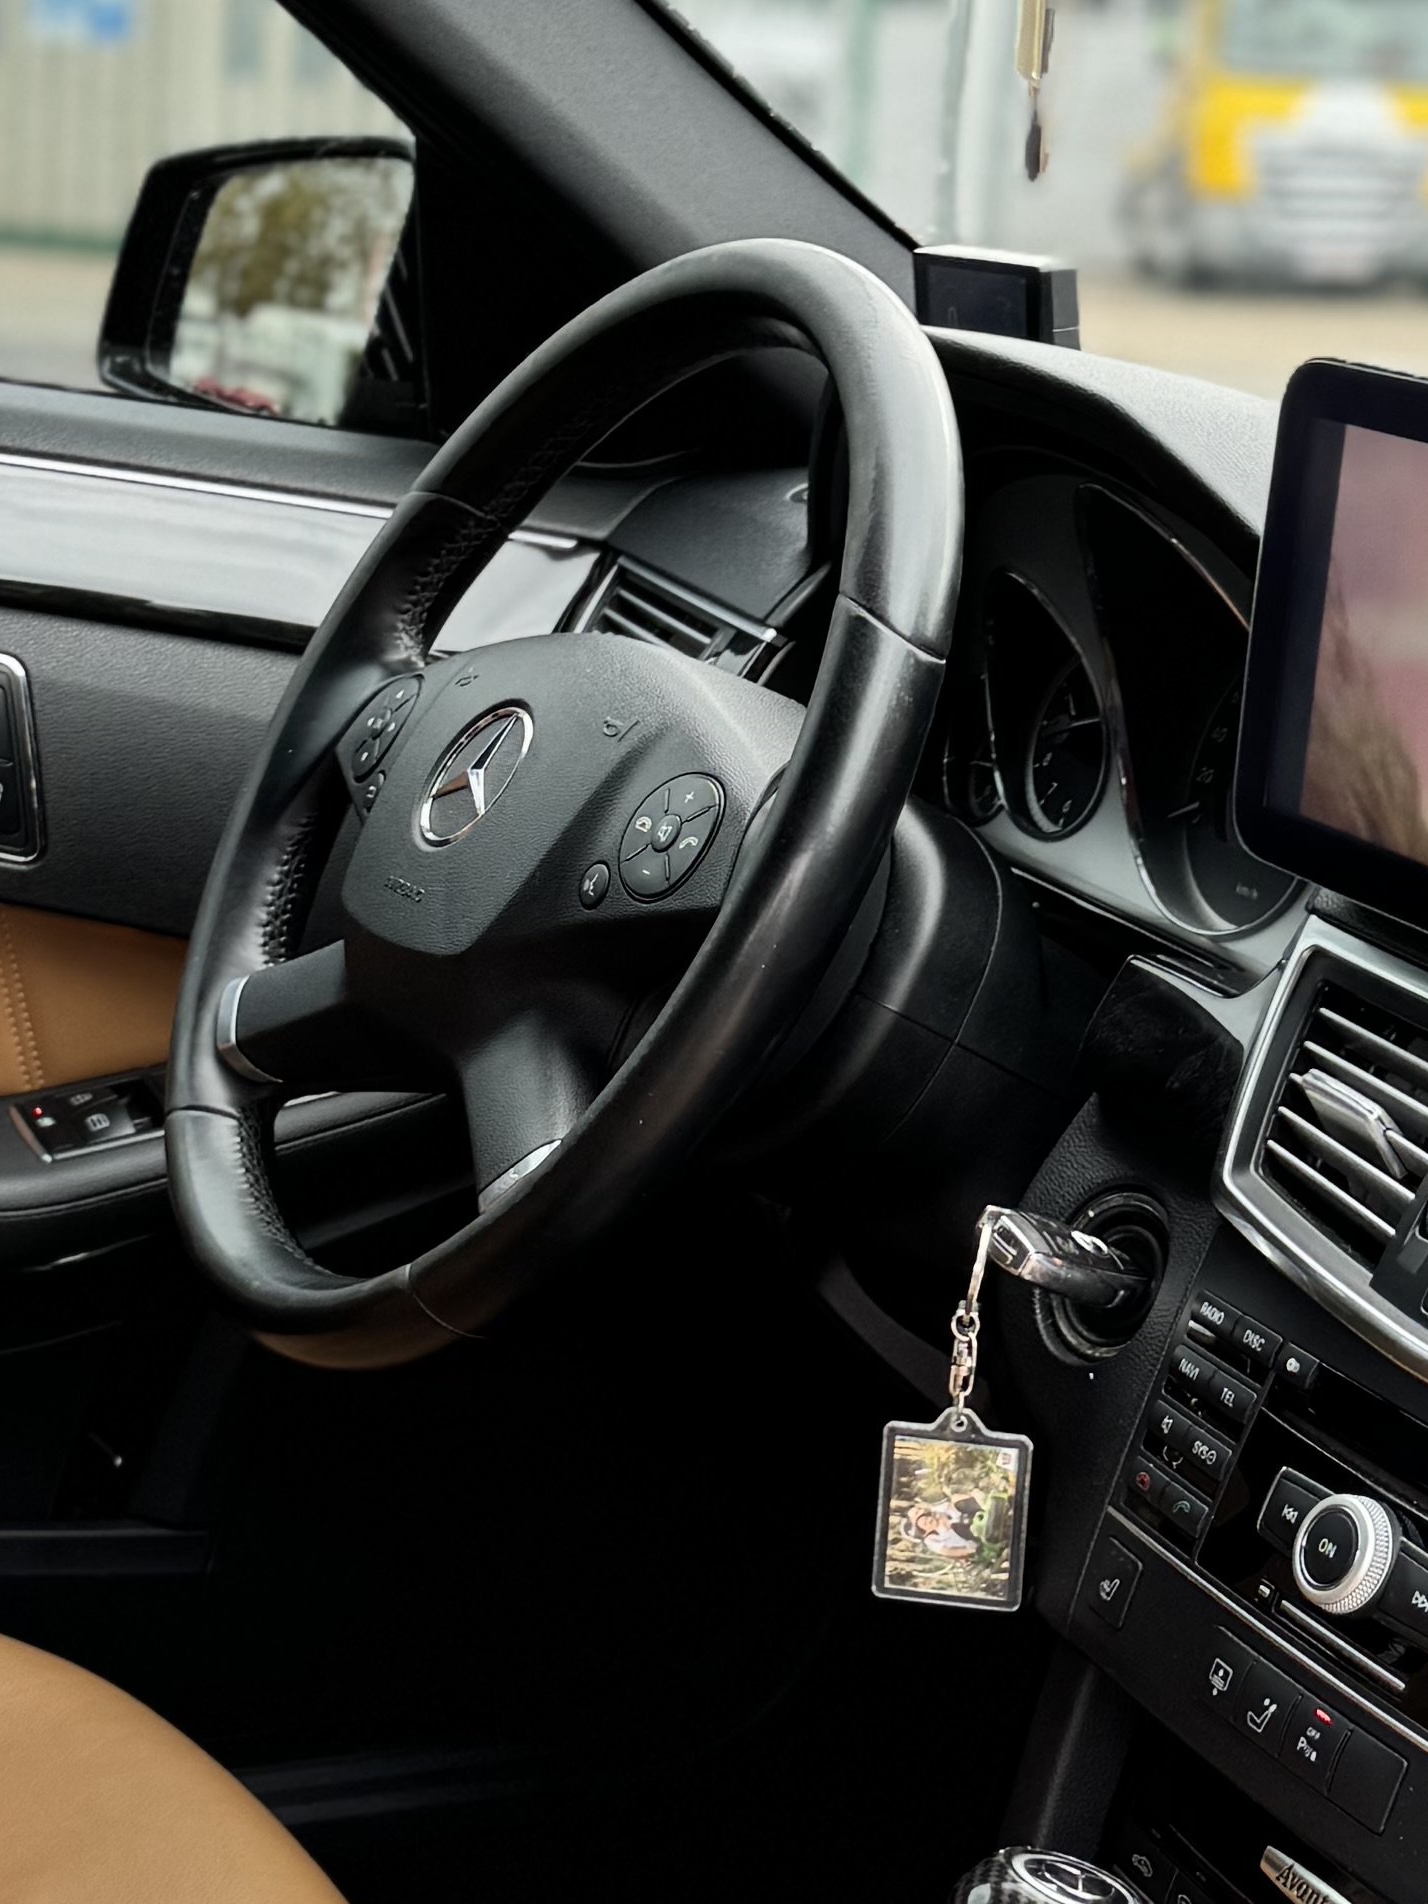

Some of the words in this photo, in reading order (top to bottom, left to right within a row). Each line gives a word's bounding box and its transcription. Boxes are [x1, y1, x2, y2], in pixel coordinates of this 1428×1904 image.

[1200, 1301, 1225, 1325] RADIO
[1242, 1329, 1266, 1352] DISC
[1178, 1358, 1200, 1381] NAVI
[1220, 1387, 1236, 1408] TEL
[1318, 1537, 1337, 1559] ON
